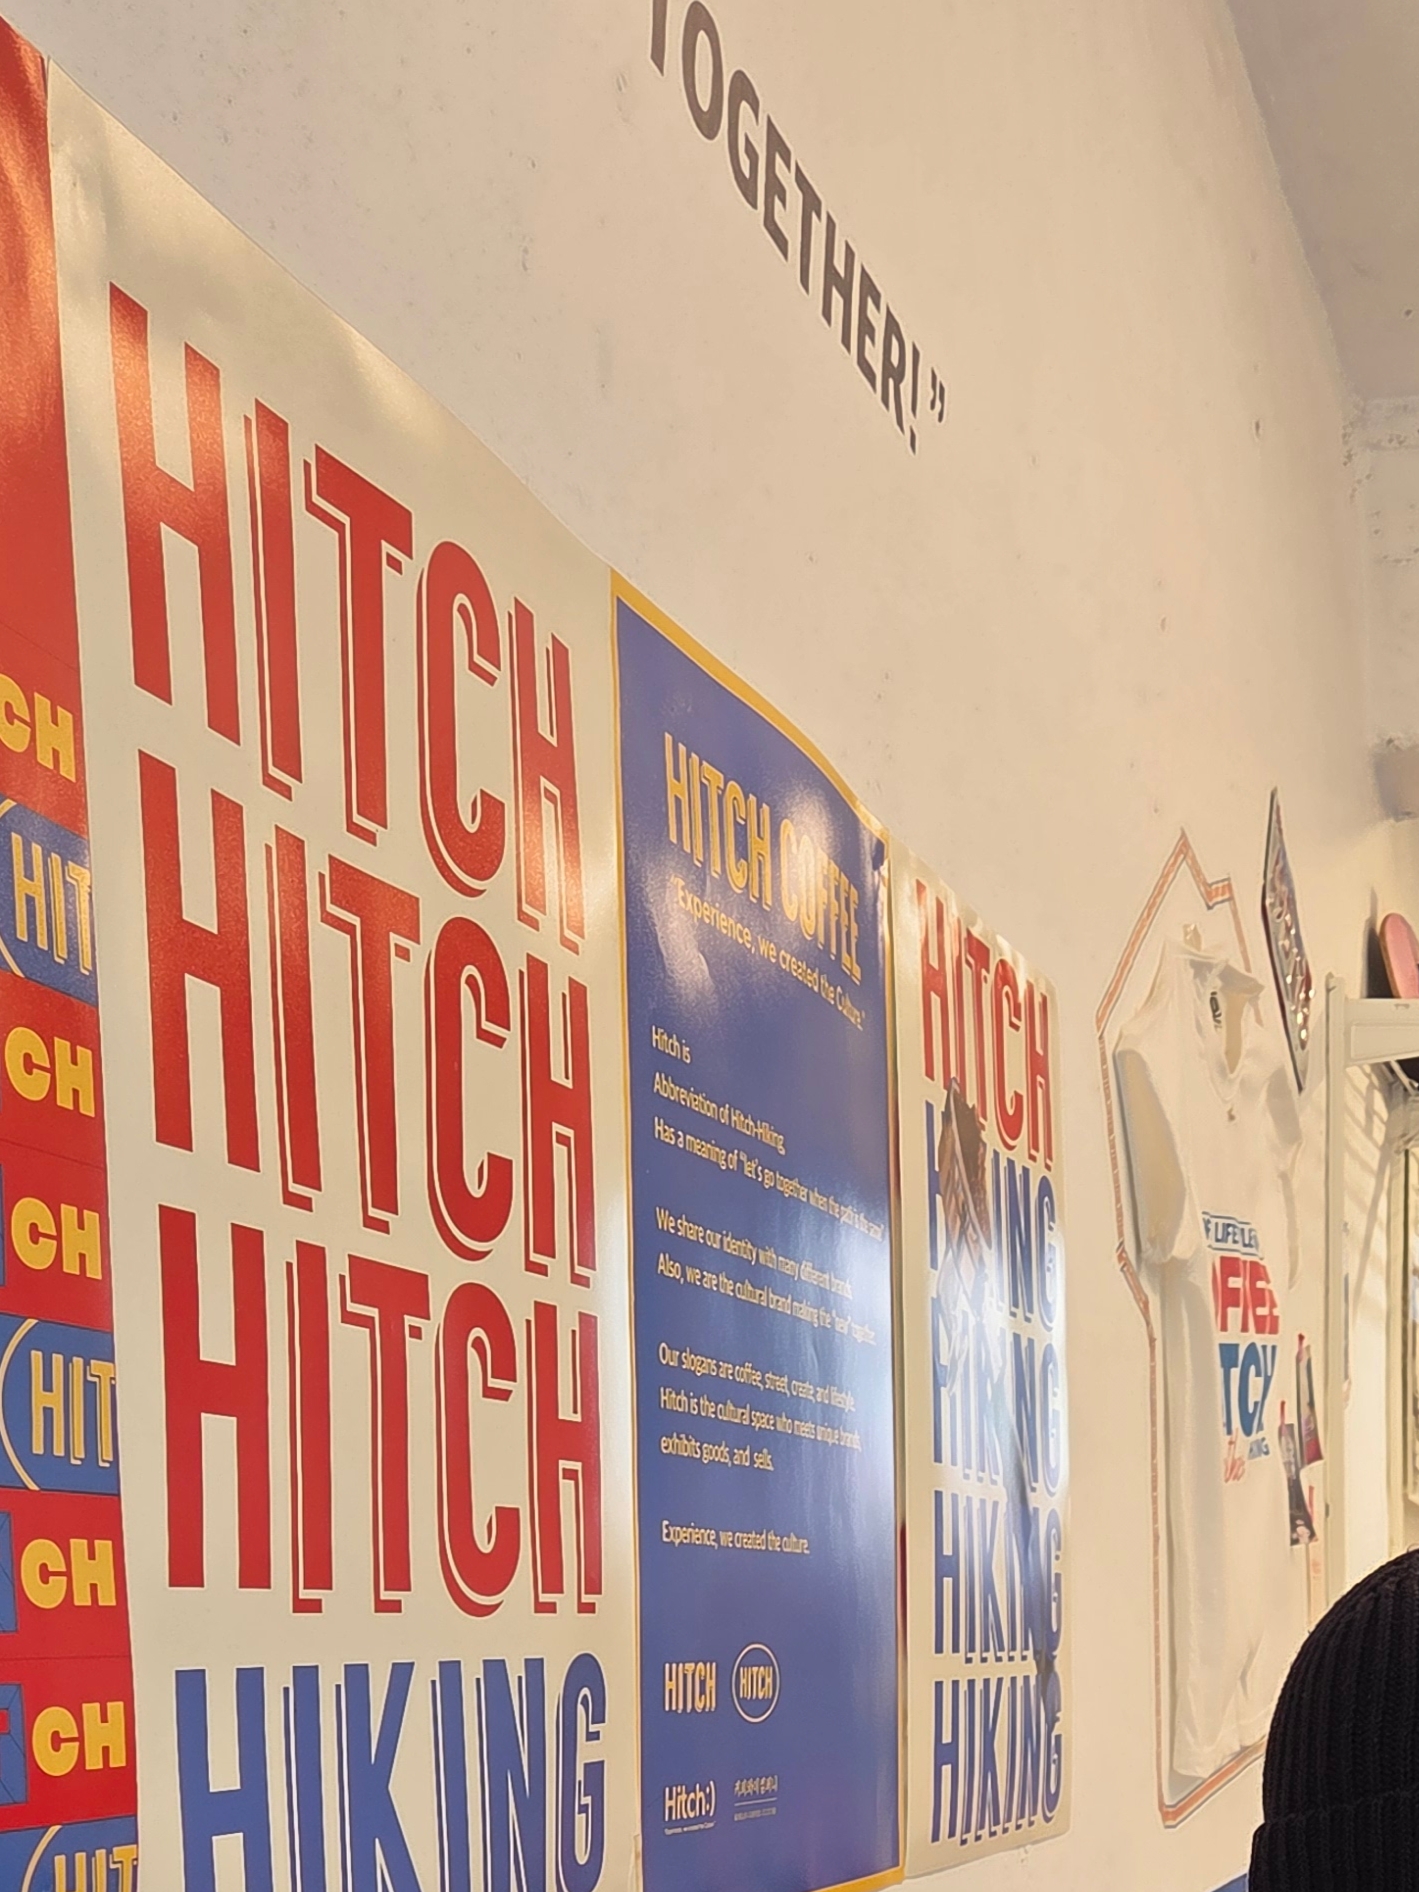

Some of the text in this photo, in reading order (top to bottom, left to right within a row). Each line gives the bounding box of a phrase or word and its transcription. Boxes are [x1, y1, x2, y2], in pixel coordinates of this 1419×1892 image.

[109, 281, 587, 954] HITCH
[664, 732, 861, 986] HITCH COFFEE
[757, 935, 777, 962] we
[778, 947, 819, 991] created
[818, 967, 836, 1005] the
[138, 748, 595, 1288] HITCH
[651, 1025, 691, 1064] Hitch is
[915, 878, 1054, 1172] HITCH
[653, 1071, 718, 1121] Abbreviation
[719, 1103, 730, 1126] of
[654, 1116, 676, 1146] Has
[676, 1130, 685, 1149] a
[685, 1140, 727, 1170] meaning
[727, 1149, 738, 1171] of
[763, 1167, 775, 1189] go
[775, 1171, 809, 1202] together
[655, 1206, 676, 1234] We
[676, 1214, 705, 1245] share
[705, 1228, 722, 1250] our
[722, 1230, 758, 1265] identity
[758, 1245, 777, 1270] with
[777, 1256, 800, 1281] many
[657, 1252, 685, 1284] Also,
[685, 1265, 702, 1287] we
[702, 1269, 718, 1292] are
[718, 1270, 735, 1296] the
[734, 1278, 768, 1307] cultural
[768, 1287, 792, 1315] brand
[792, 1299, 819, 1328] making
[819, 1306, 832, 1329] the
[658, 1341, 680, 1366] Our
[681, 1346, 717, 1377] slogans
[718, 1360, 734, 1381] are
[734, 1361, 764, 1391] coffee,
[764, 1370, 790, 1397] street,
[816, 1385, 831, 1405] and
[158, 1203, 604, 1617] HITCH
[660, 1386, 688, 1411] Hitch
[689, 1392, 699, 1416] is
[700, 1393, 716, 1418] the
[717, 1400, 751, 1426] cultural
[751, 1409, 775, 1432] space
[775, 1412, 793, 1434] who
[793, 1417, 816, 1440] meets
[816, 1423, 840, 1448] unique
[660, 1432, 701, 1459] exhibits
[701, 1441, 732, 1467] goods,
[732, 1445, 750, 1467] and
[662, 1520, 719, 1549] Experience,
[719, 1530, 733, 1547] we
[733, 1529, 767, 1551] created
[766, 1531, 781, 1552] the
[663, 1661, 717, 1713] HITCH
[739, 1666, 774, 1700] HITCH
[931, 1671, 1063, 1848] HIKING
